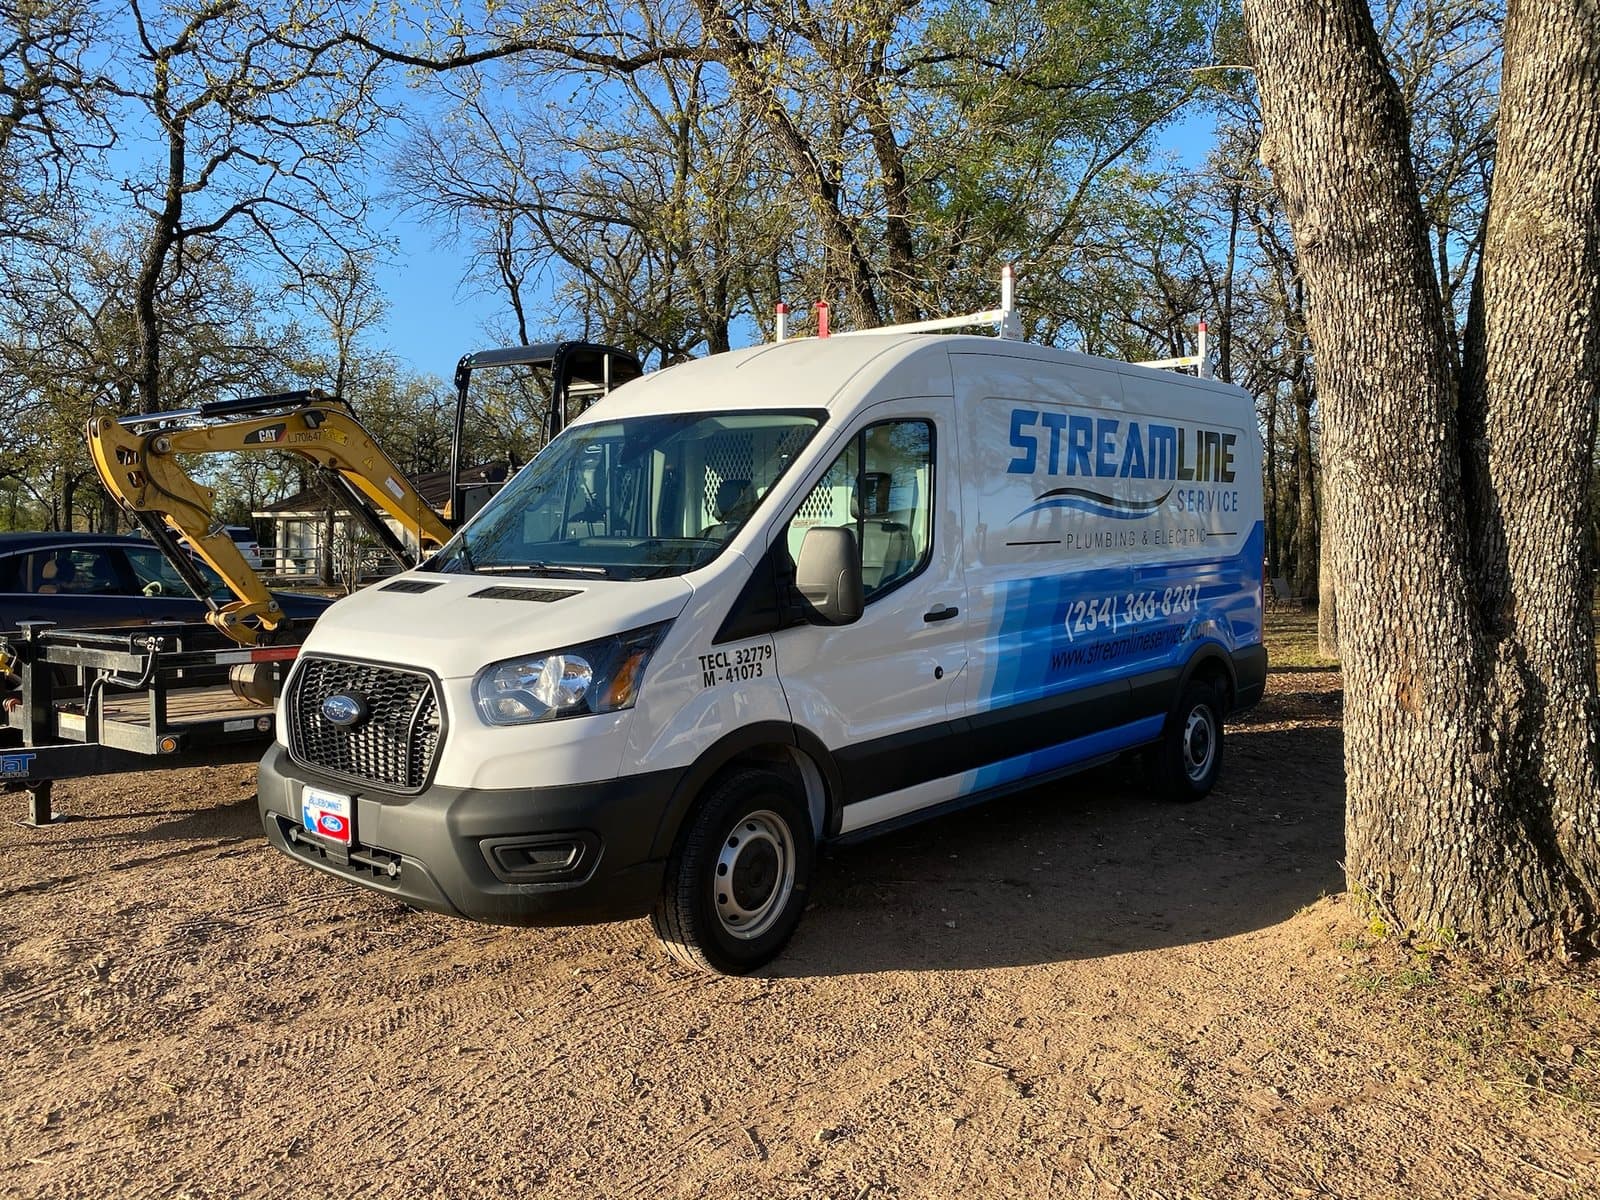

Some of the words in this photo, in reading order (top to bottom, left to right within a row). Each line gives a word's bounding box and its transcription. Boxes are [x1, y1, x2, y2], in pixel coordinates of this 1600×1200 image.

[258, 429, 276, 442] CAT
[1007, 408, 1237, 483] STREAMLINE
[1177, 489, 1238, 512] SERVICE
[1066, 530, 1136, 550] PLUMBING
[1142, 532, 1149, 546] &
[1154, 528, 1207, 545] ELECTRIC
[1065, 595, 1118, 642] (254)
[698, 651, 731, 671] TECL
[735, 644, 772, 665] 32779
[703, 671, 716, 688] M
[726, 662, 762, 682] 41073
[323, 816, 340, 831] Ford
